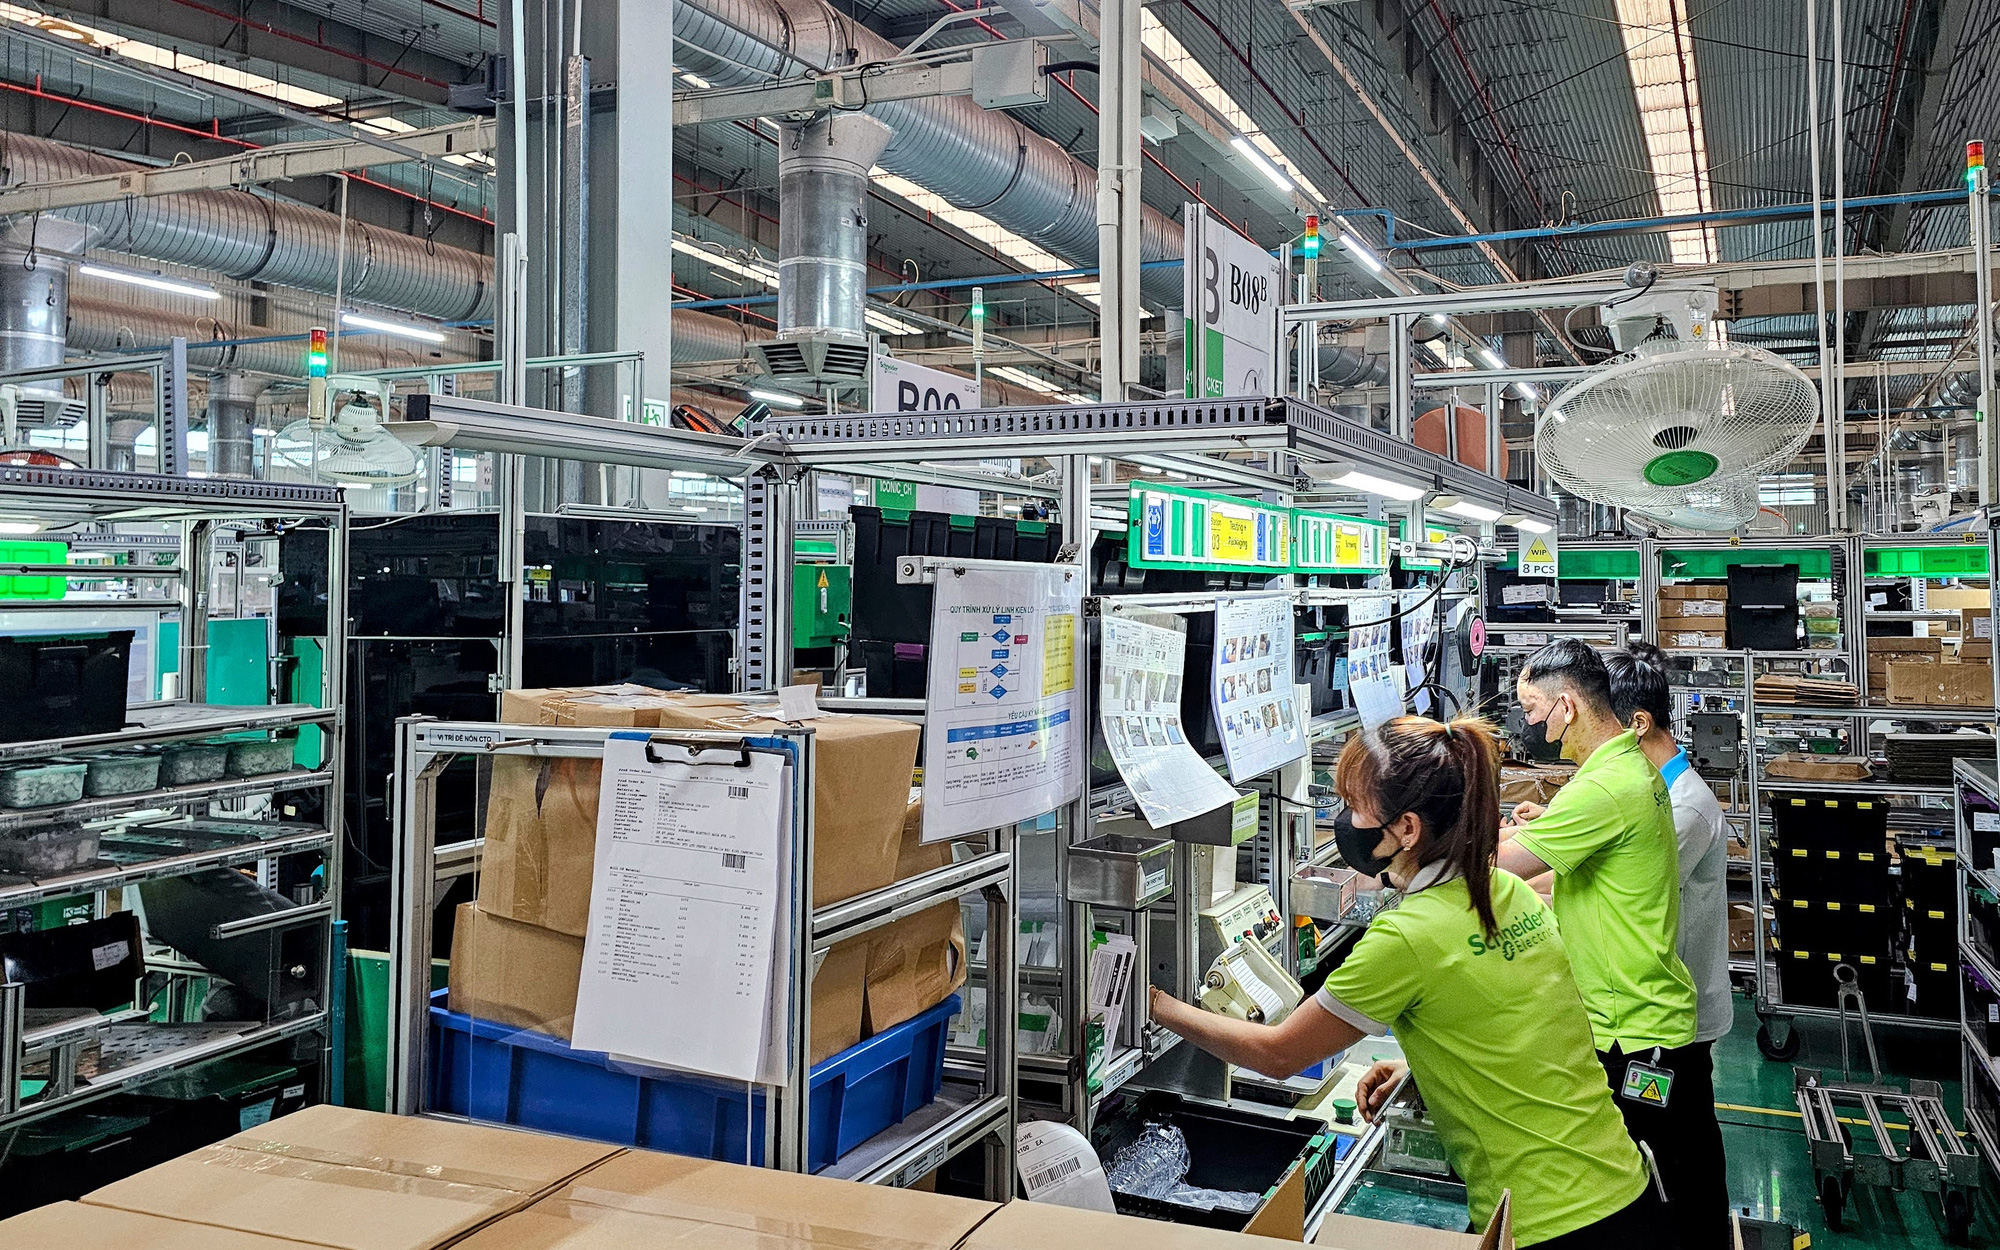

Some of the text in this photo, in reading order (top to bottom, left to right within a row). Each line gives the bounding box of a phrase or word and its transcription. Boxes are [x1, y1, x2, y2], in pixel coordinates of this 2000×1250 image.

[1229, 262, 1267, 315] B08B
[1207, 376, 1223, 395] CKET
[1523, 564, 1555, 574] 8 PCS
